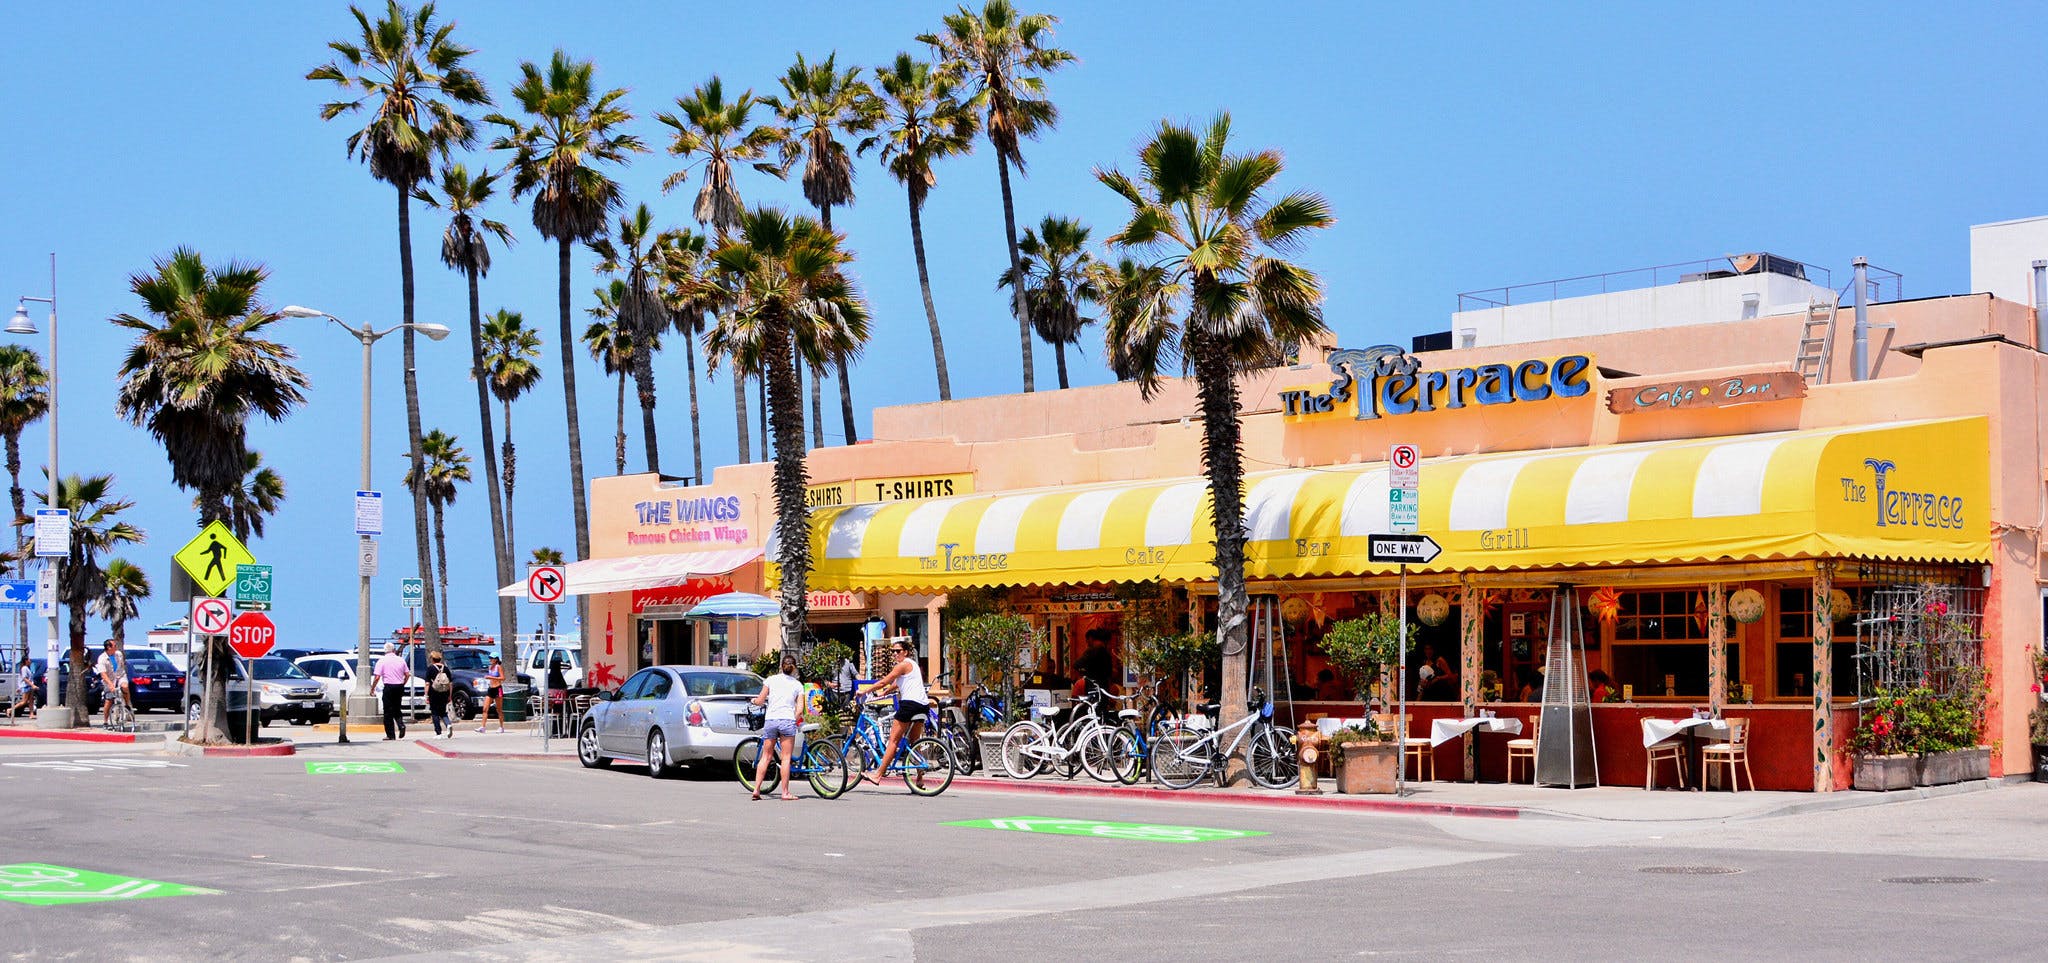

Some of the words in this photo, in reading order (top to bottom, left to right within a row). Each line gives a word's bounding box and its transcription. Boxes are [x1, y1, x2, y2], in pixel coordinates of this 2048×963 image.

[1278, 390, 1334, 417] The
[1327, 344, 1591, 421] Terrace
[1633, 385, 1694, 408] Cafe
[1717, 378, 1771, 399] Bar
[804, 486, 843, 507] -SHIRTS
[875, 478, 954, 502] T-SHIRTS
[1392, 490, 1400, 501] 2
[1841, 476, 1867, 503] The
[1863, 457, 1965, 530] Terrace
[635, 501, 673, 525] THE
[676, 495, 741, 523] WINGS
[1391, 503, 1417, 513] PARKING
[627, 531, 666, 545] Famous
[668, 527, 711, 544] Chicken
[713, 525, 748, 544] Wings
[1480, 527, 1530, 550] Grill
[919, 556, 938, 570] The
[938, 543, 1009, 571] Terrace
[1125, 546, 1165, 565] Cafe
[1295, 538, 1331, 558] Bar
[1376, 543, 1397, 554] ONE
[1400, 543, 1422, 554] WAY
[251, 593, 269, 601] ROUTE
[636, 596, 669, 607] Hot
[232, 625, 273, 644] STOP
